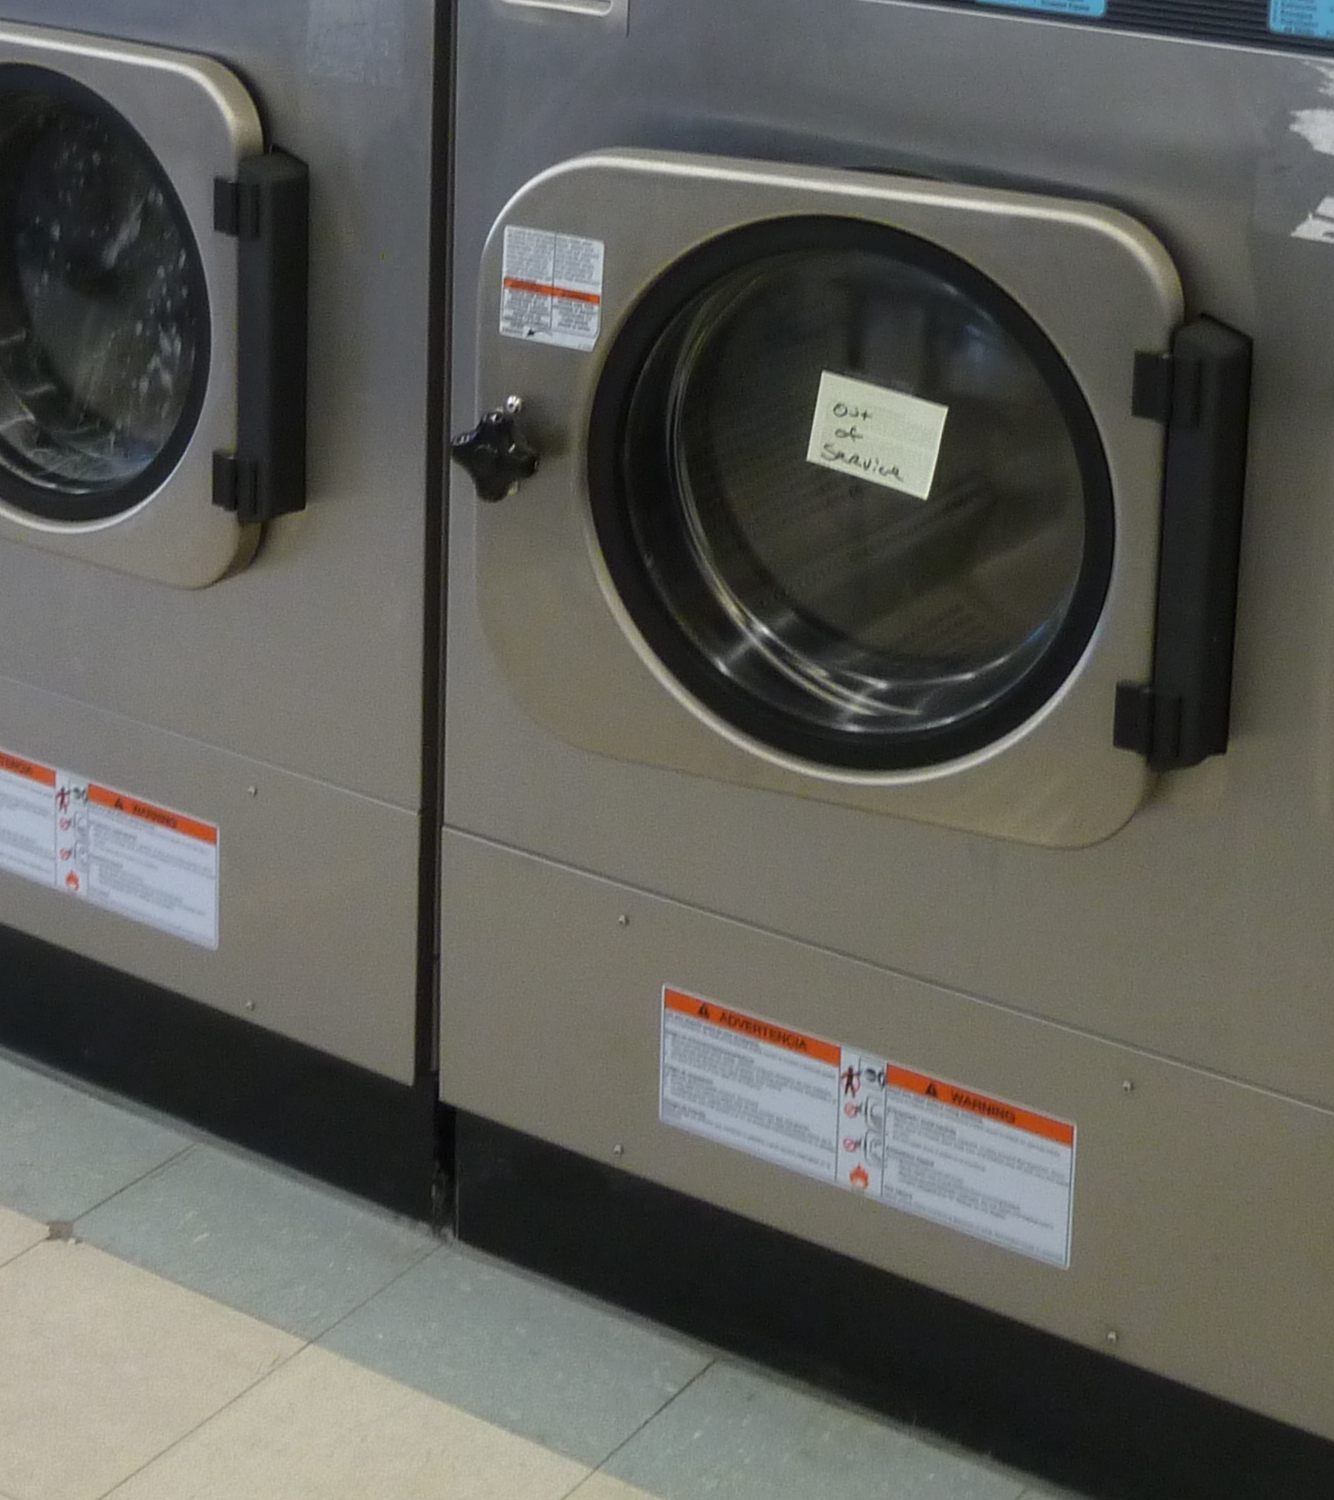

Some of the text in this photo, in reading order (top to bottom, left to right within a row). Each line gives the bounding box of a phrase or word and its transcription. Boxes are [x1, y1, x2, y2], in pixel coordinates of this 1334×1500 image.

[833, 403, 872, 420] Out
[835, 426, 863, 442] of
[719, 1011, 807, 1049] ADVERTENCIA
[950, 1089, 1015, 1124] WARNING
